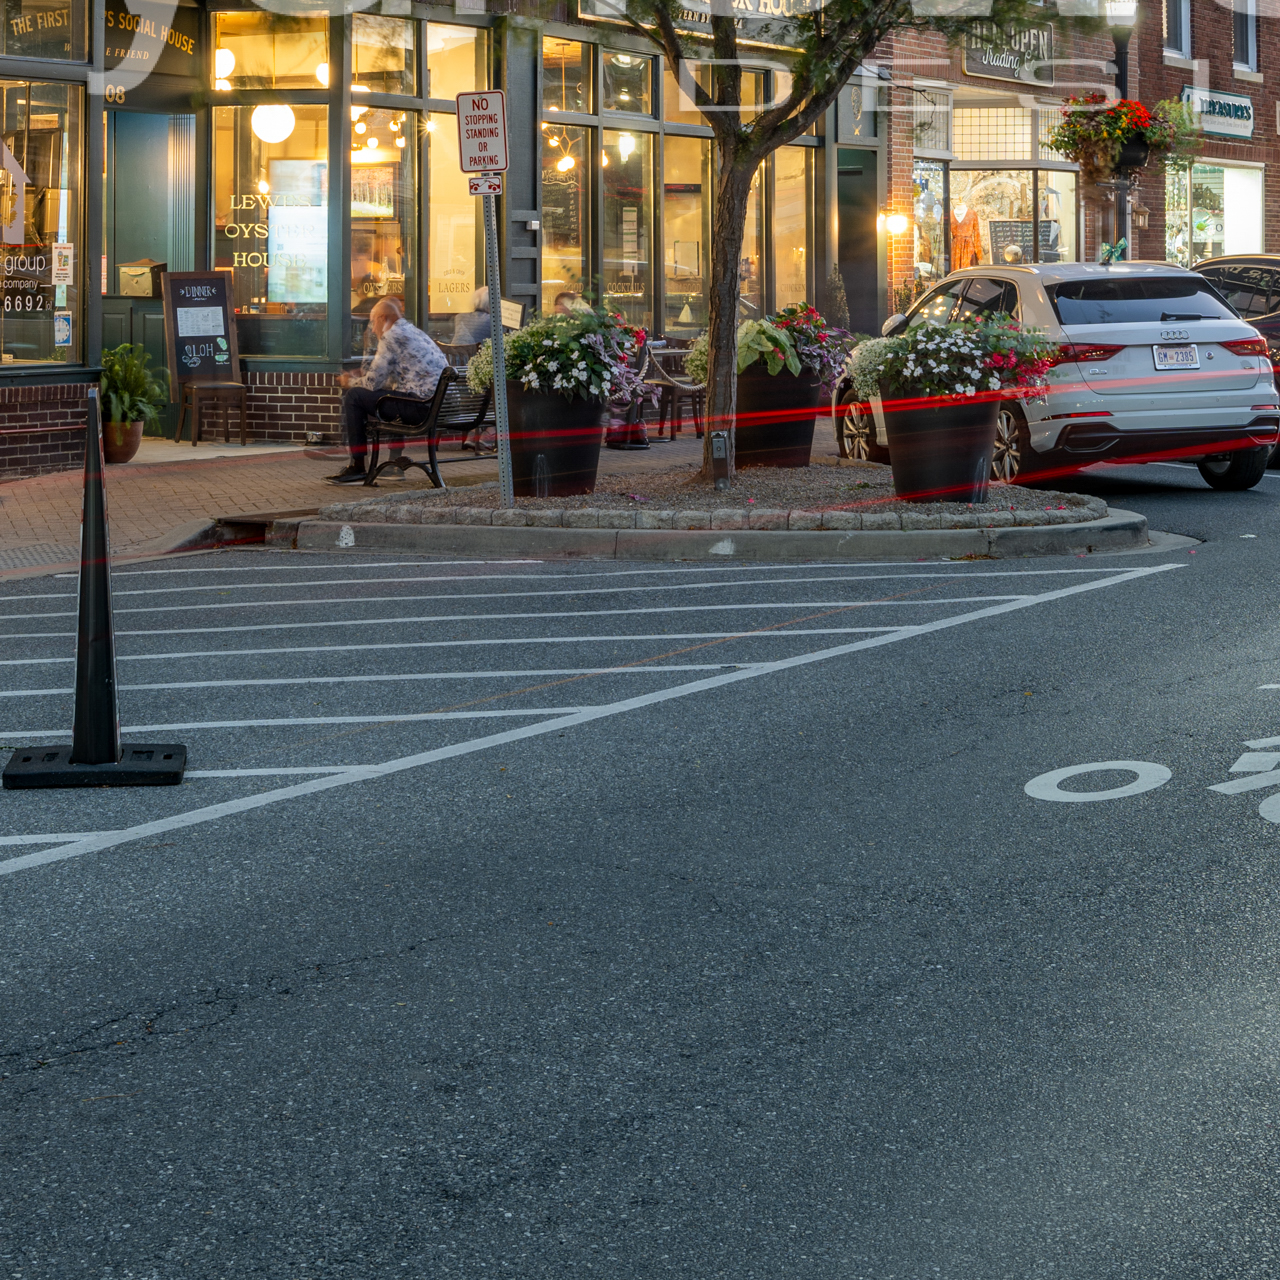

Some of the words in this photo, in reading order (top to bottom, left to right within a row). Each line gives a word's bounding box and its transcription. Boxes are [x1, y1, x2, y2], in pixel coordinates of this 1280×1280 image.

[10, 15, 34, 36] THE
[36, 9, 69, 30] FIRST
[119, 13, 157, 38] SOCIAL
[160, 25, 195, 55] HOUSE
[114, 47, 149, 60] FRIEND
[982, 43, 1020, 77] Trading
[105, 84, 126, 104] 08
[472, 98, 489, 111] NO
[1199, 97, 1252, 121] TREASURES
[465, 113, 498, 126] STOPPING
[466, 127, 499, 139] STANDING
[478, 142, 488, 152] OR
[469, 155, 499, 166] PARKING
[230, 194, 311, 210] LEWES
[224, 223, 315, 239] OYSTER
[4, 255, 46, 276] group
[233, 252, 307, 268] HOUSE
[3, 279, 38, 291] company
[185, 285, 213, 297] DINNER
[438, 282, 470, 293] LAGERS
[607, 282, 645, 293] COCKTAILS
[1158, 352, 1168, 362] GM
[1175, 351, 1194, 362] 2385
